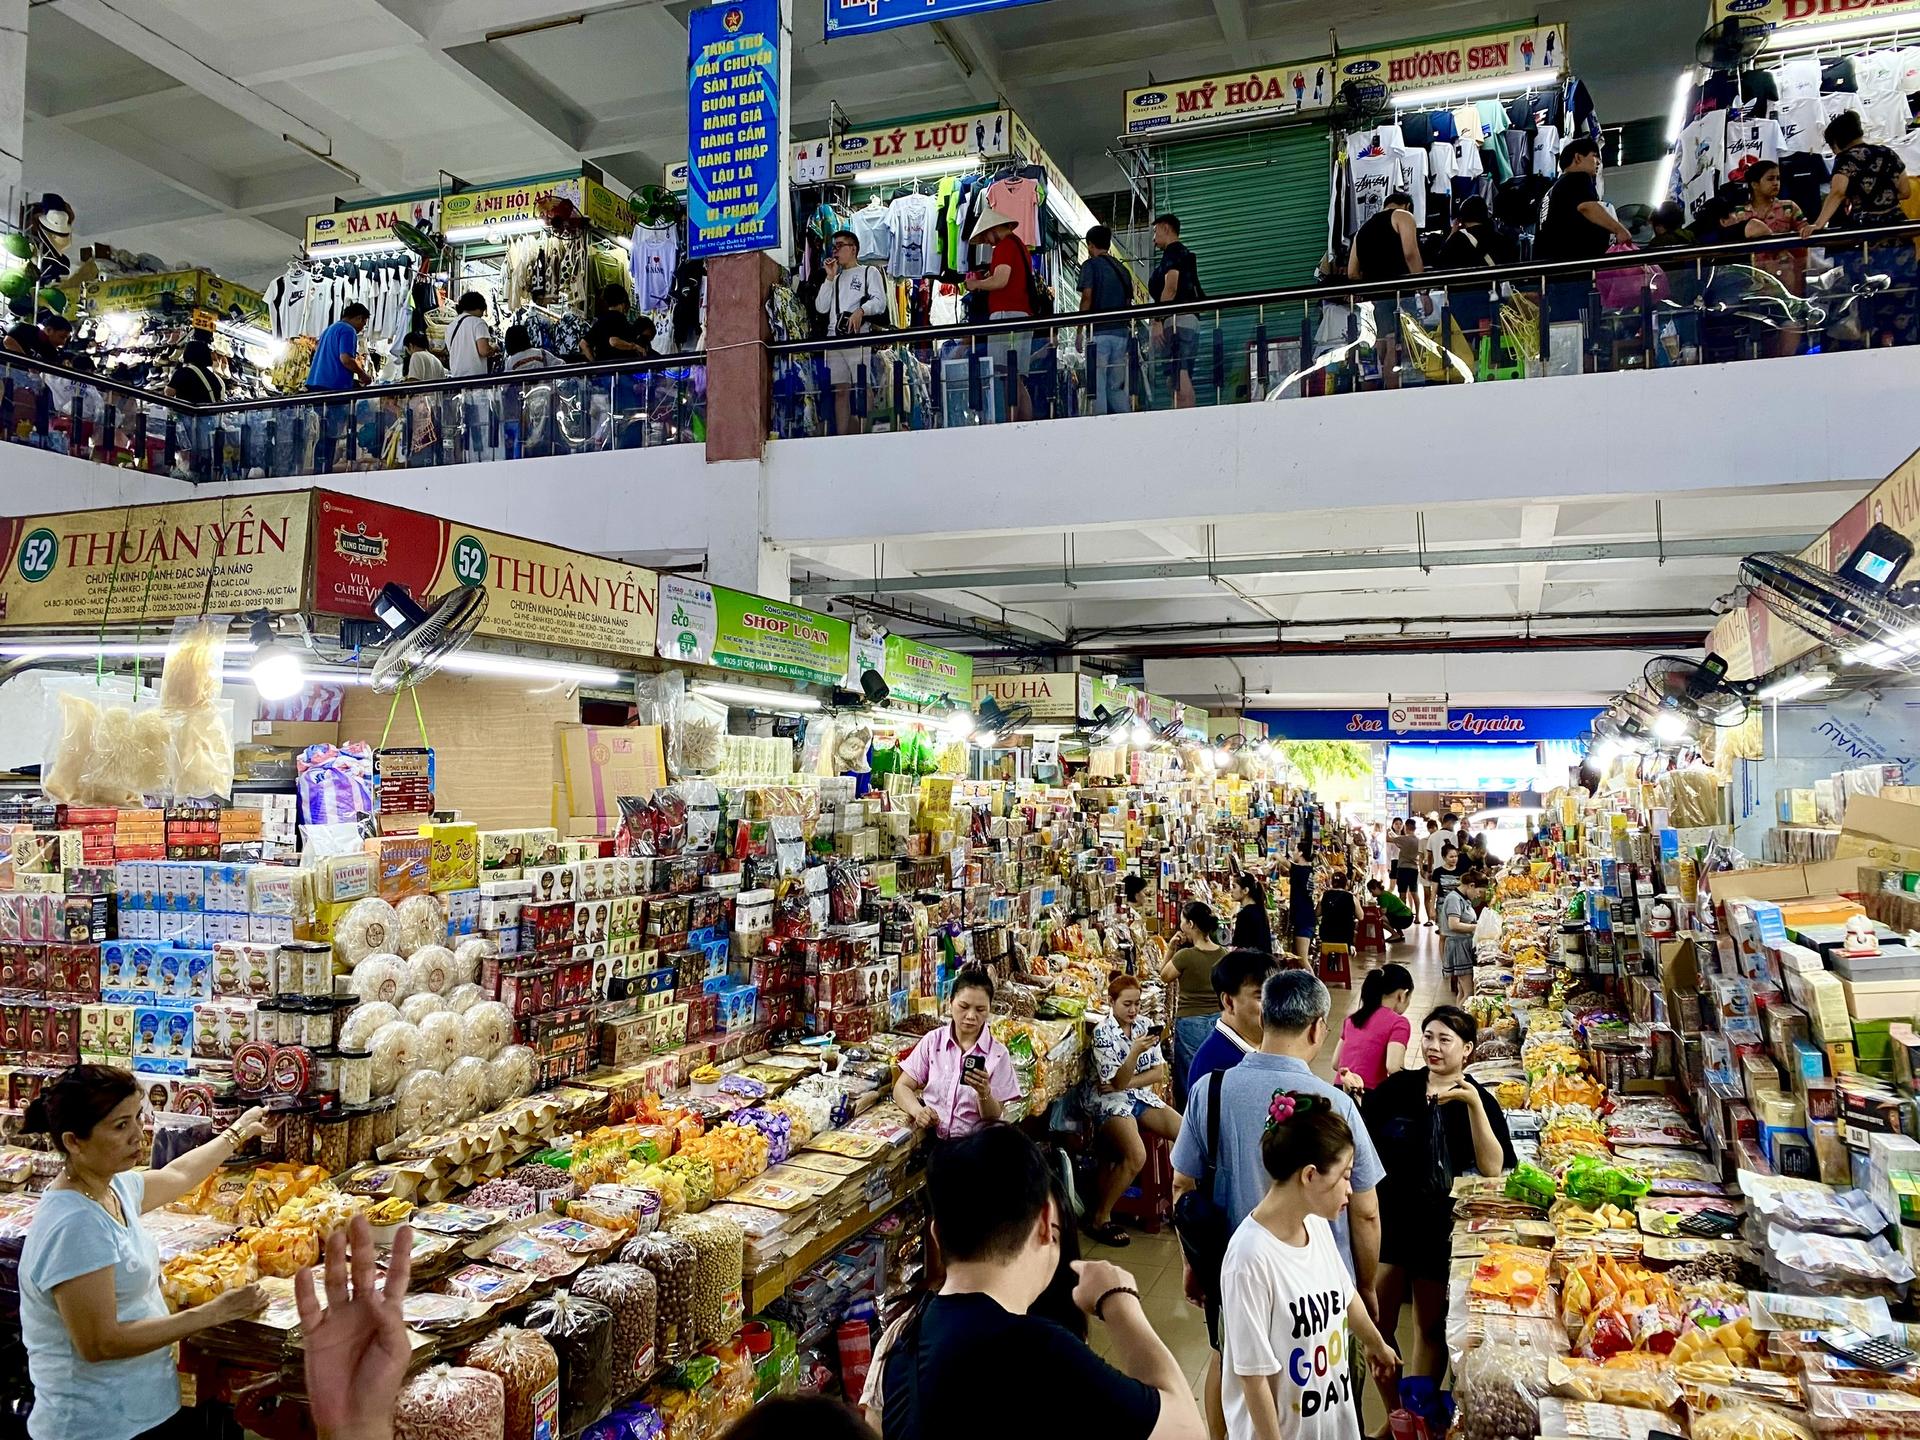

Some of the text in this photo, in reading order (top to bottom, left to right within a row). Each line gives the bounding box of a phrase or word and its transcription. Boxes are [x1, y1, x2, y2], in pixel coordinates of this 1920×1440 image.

[695, 50, 772, 78] VẬN CHUYỂN
[1388, 41, 1510, 83] HƯƠNG SEN
[703, 70, 763, 94] SẢN XUẤT
[1175, 74, 1285, 113] MỸ HÒA
[702, 90, 765, 113] BUÔN BÁN
[703, 106, 763, 131] HÀNG GIẢ
[700, 124, 766, 149] HÀNG CẤM
[873, 122, 968, 157] LÝ LỰU
[698, 144, 768, 168] HÀNG NHẬP
[712, 164, 753, 185] LẬU LÀ
[506, 190, 529, 210] HỘI
[708, 184, 758, 203] HÀNH VI
[346, 215, 371, 234] NA
[376, 211, 399, 229] NA
[706, 202, 759, 222] VI PHẠM
[699, 219, 765, 241] PHÁP LUẬT
[24, 505, 290, 572] 52 THUẬN YẾN
[342, 540, 380, 555] KING COFFEE
[120, 571, 140, 583] KINH
[227, 563, 254, 575] NẴNG
[350, 572, 371, 587] VUA
[458, 544, 656, 617] 52 THUẬN YẾN
[334, 581, 346, 594] CÀ
[347, 583, 364, 598] PHÊ
[510, 600, 537, 613] CHUYÊN
[537, 604, 553, 616] KINH
[612, 616, 629, 628] NẴNG
[671, 614, 689, 628] eco
[764, 605, 780, 616] CÔNG
[743, 613, 829, 646] SHOP LOAN
[744, 660, 754, 670] CHỢ
[936, 662, 957, 677] ANH
[1022, 677, 1053, 698] HÀ
[1346, 712, 1526, 736] See Again
[494, 835, 508, 845] Coffee
[1289, 1289, 1342, 1339] HAVE
[1301, 1367, 1350, 1418] DAY
